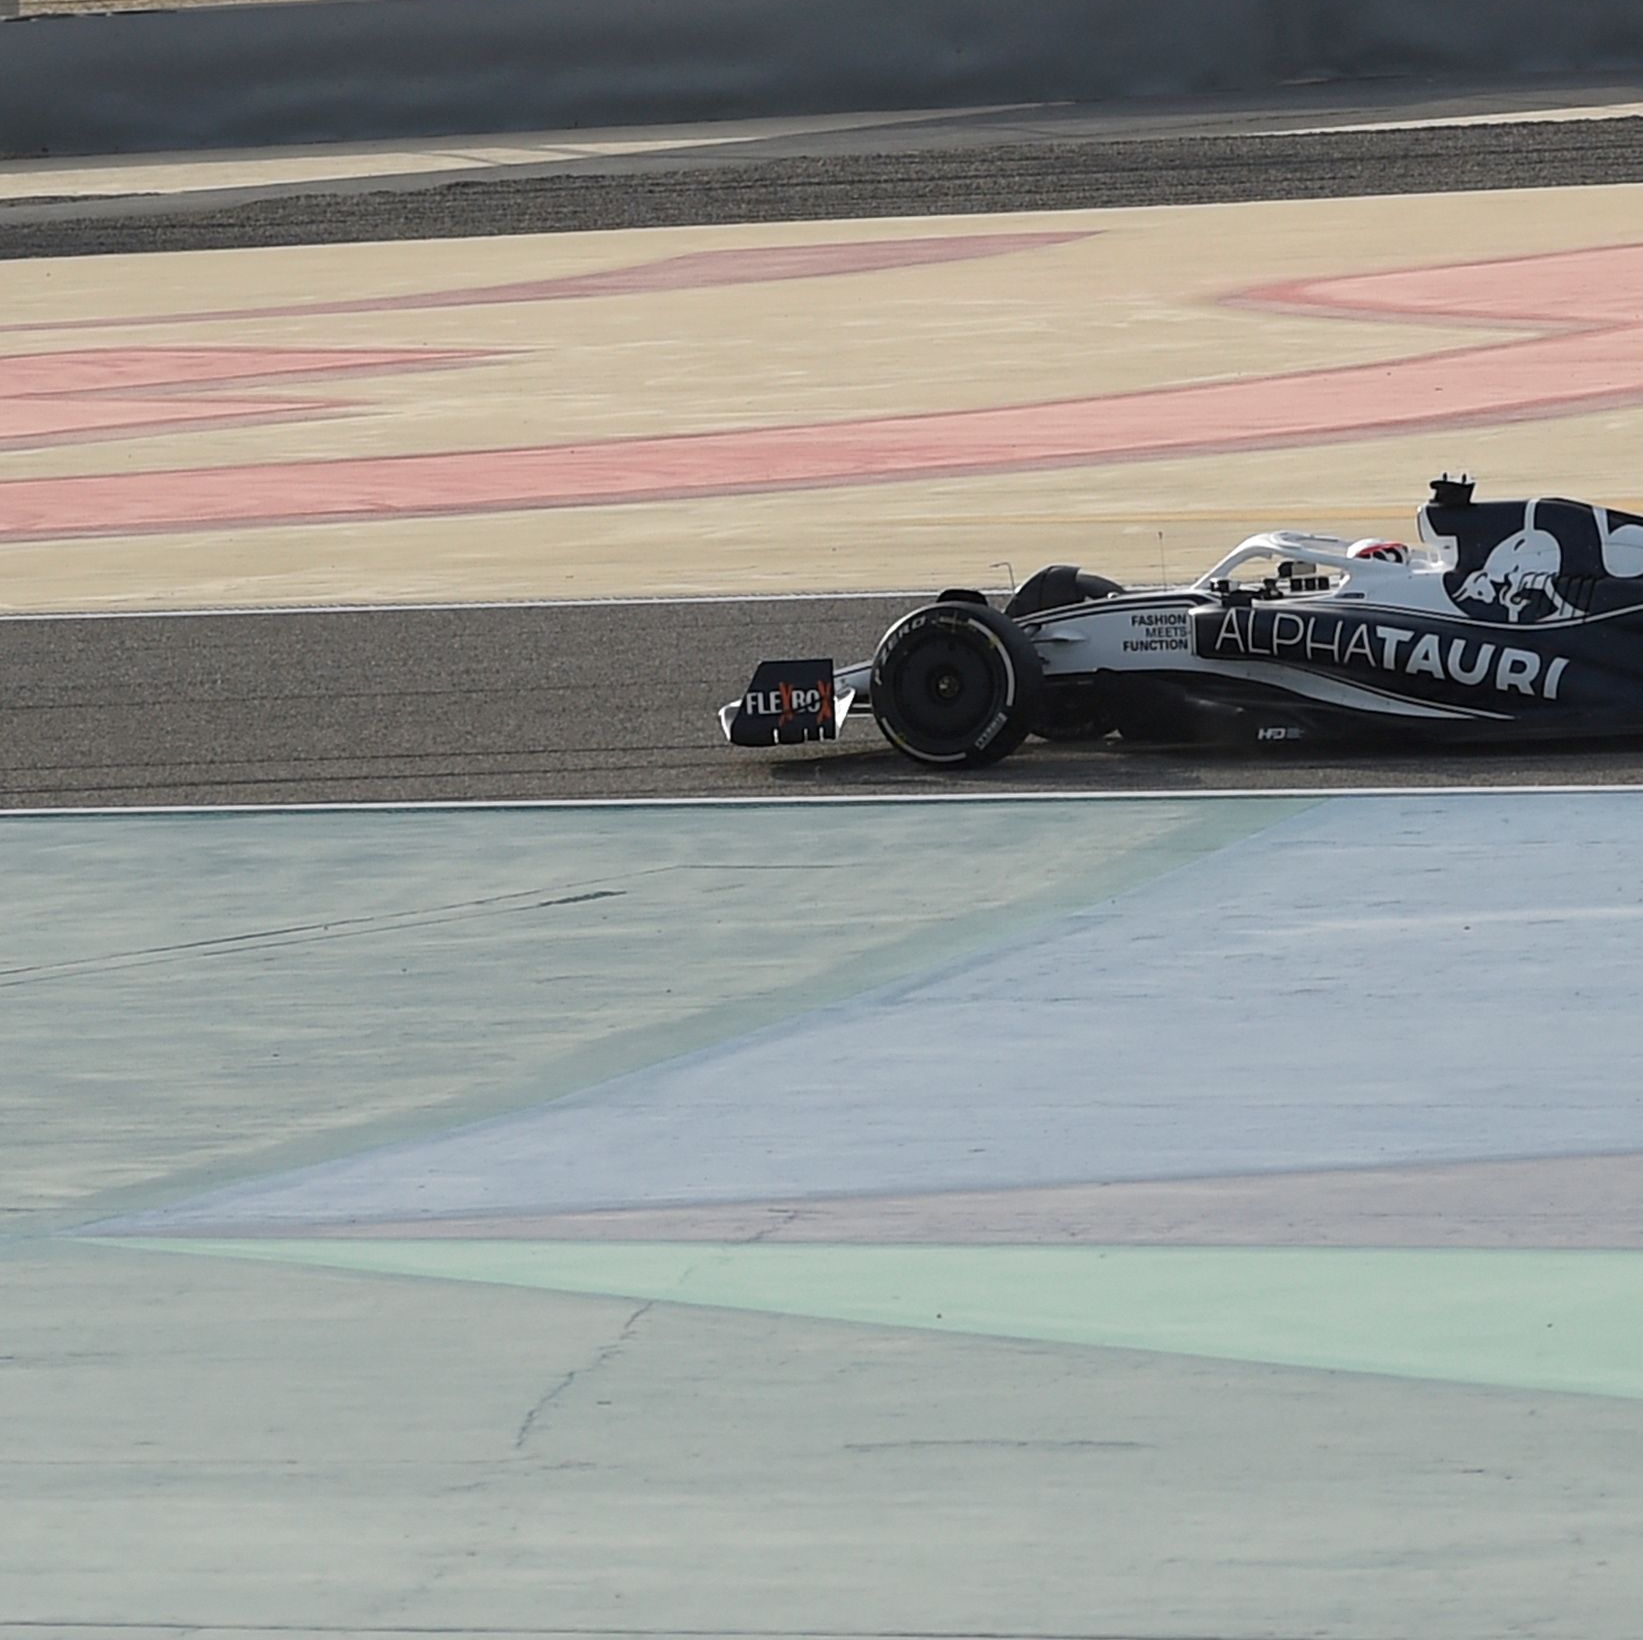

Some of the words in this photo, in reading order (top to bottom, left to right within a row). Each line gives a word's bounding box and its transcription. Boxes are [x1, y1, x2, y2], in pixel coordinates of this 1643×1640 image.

[1131, 614, 1187, 626] FASHION
[1145, 626, 1187, 638] MEETS
[1123, 639, 1188, 652] FUNCTION
[1214, 607, 1570, 700] ALPHATAURI
